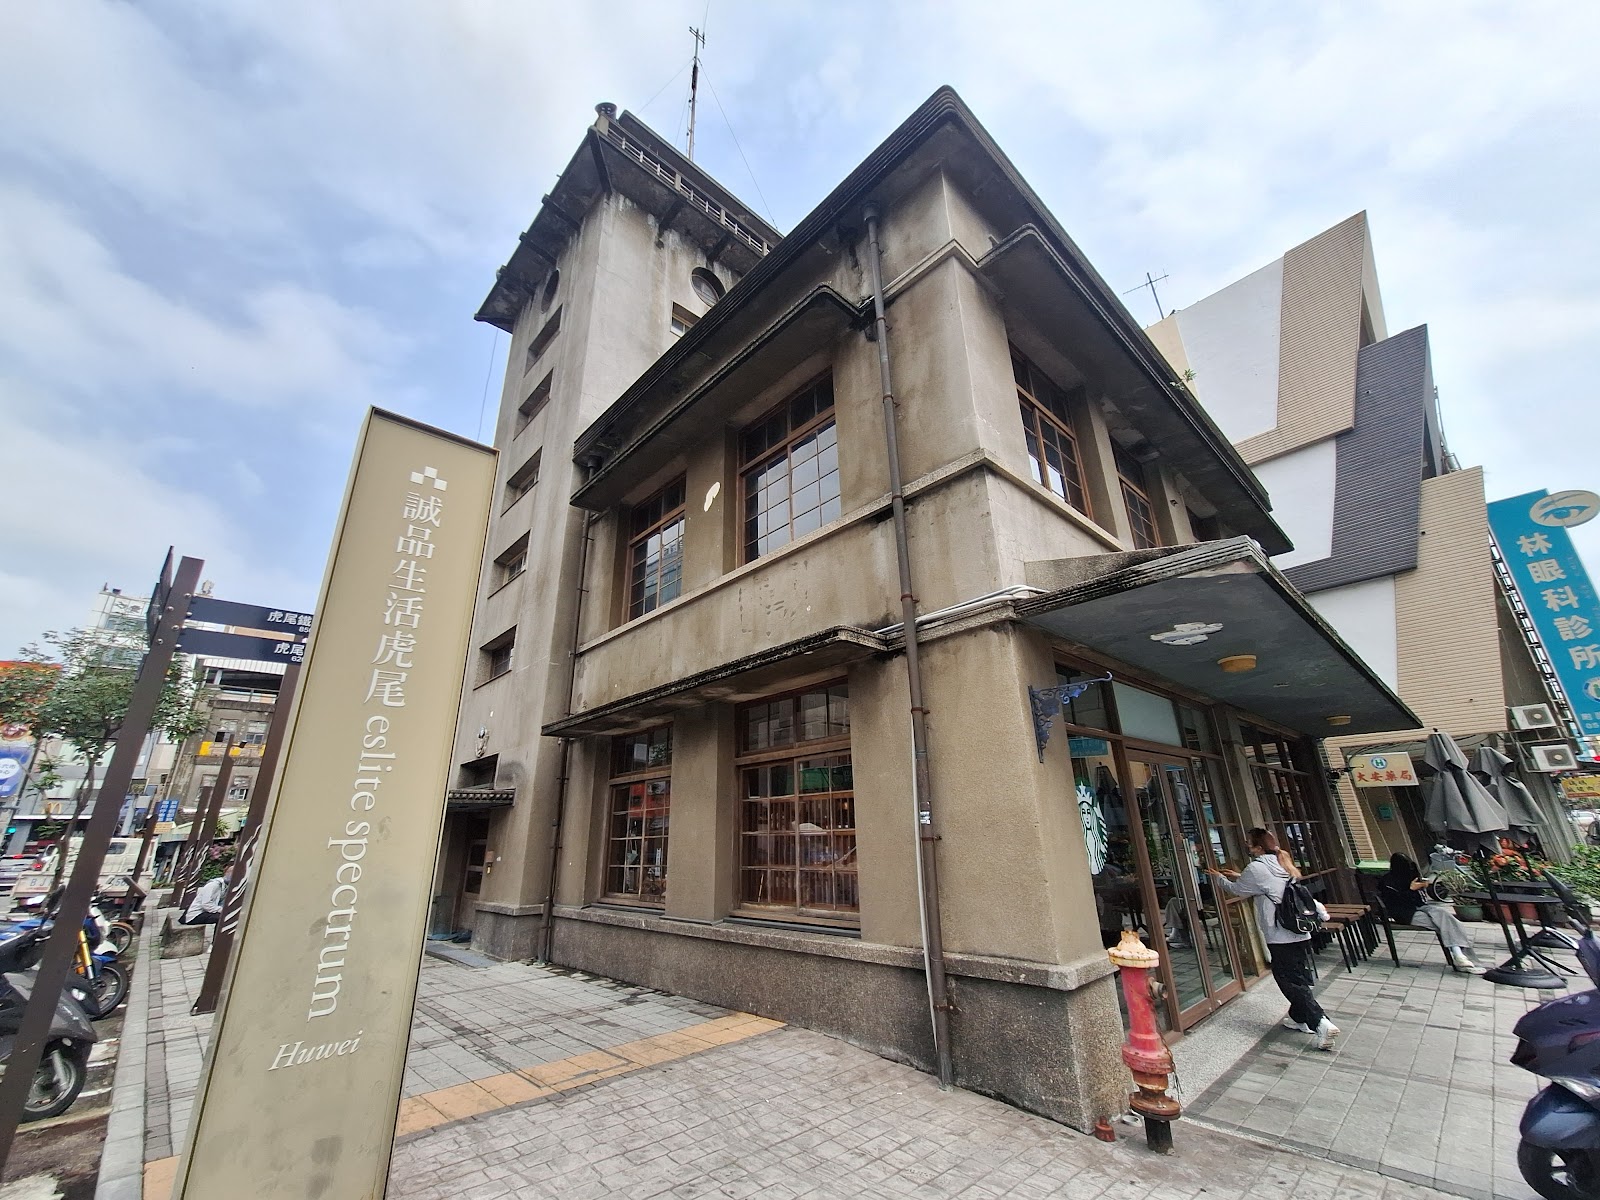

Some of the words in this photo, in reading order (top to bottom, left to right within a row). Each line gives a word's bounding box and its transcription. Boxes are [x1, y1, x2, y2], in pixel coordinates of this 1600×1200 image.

[274, 642, 305, 656] 虎尾
[363, 491, 443, 708] 誠品生活虎尾
[1516, 532, 1600, 671] 林眼科診所
[351, 715, 396, 812] eslite
[308, 820, 371, 1023] spectrum
[268, 1030, 364, 1071] Huwei
